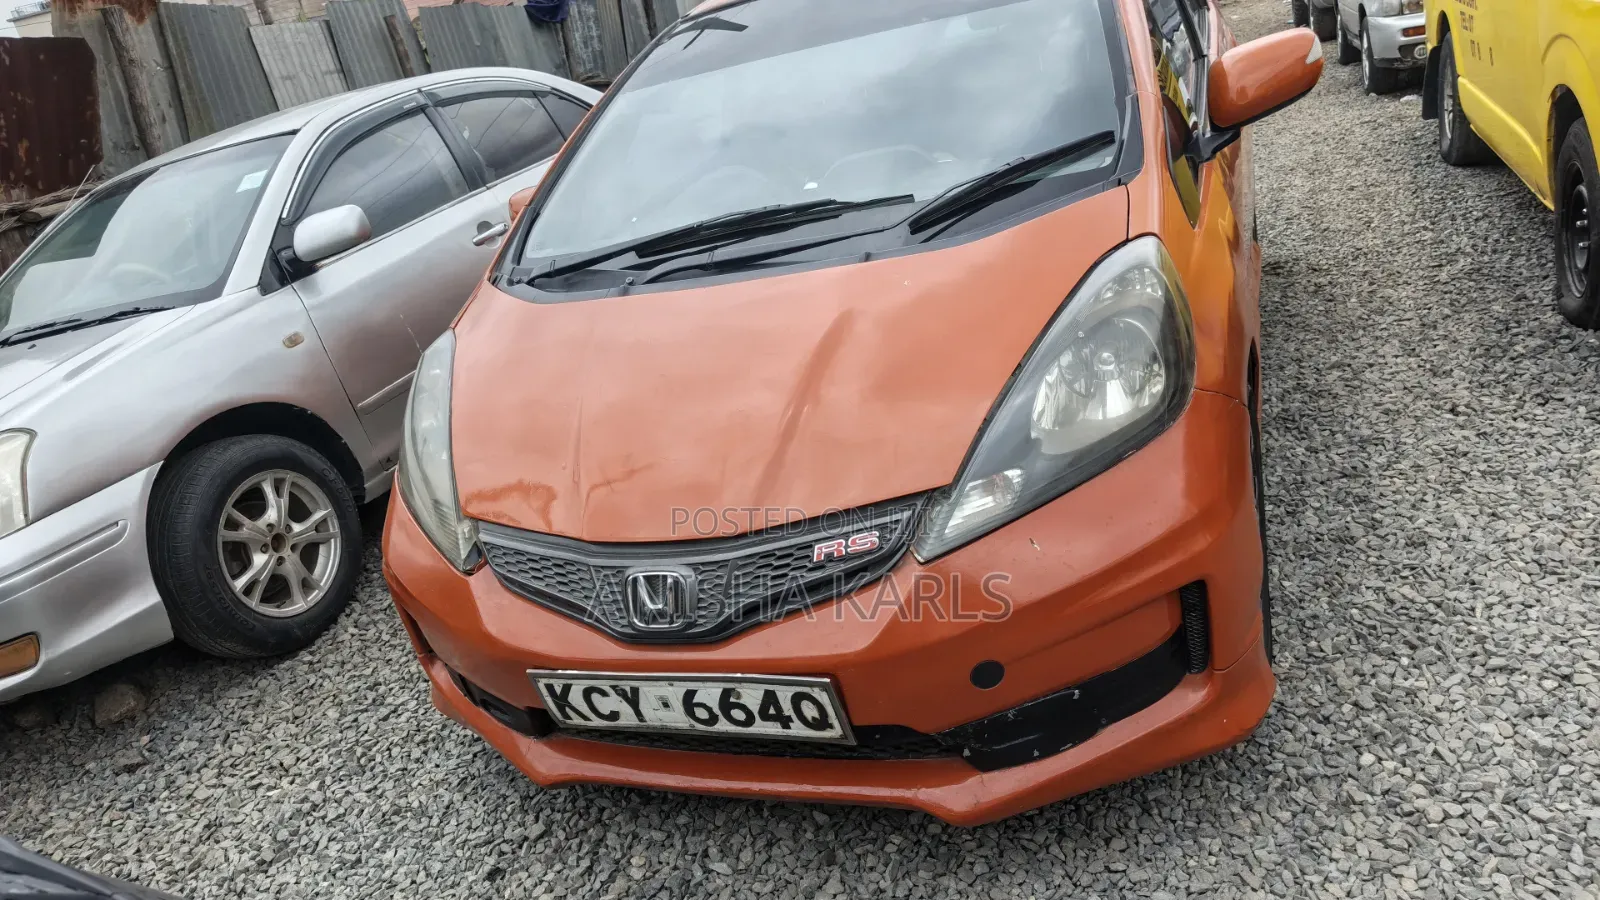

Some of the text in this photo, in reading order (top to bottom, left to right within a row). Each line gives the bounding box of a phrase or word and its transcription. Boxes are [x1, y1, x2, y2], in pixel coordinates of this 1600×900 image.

[813, 530, 880, 563] RS
[544, 683, 834, 732] KCY 664Q
